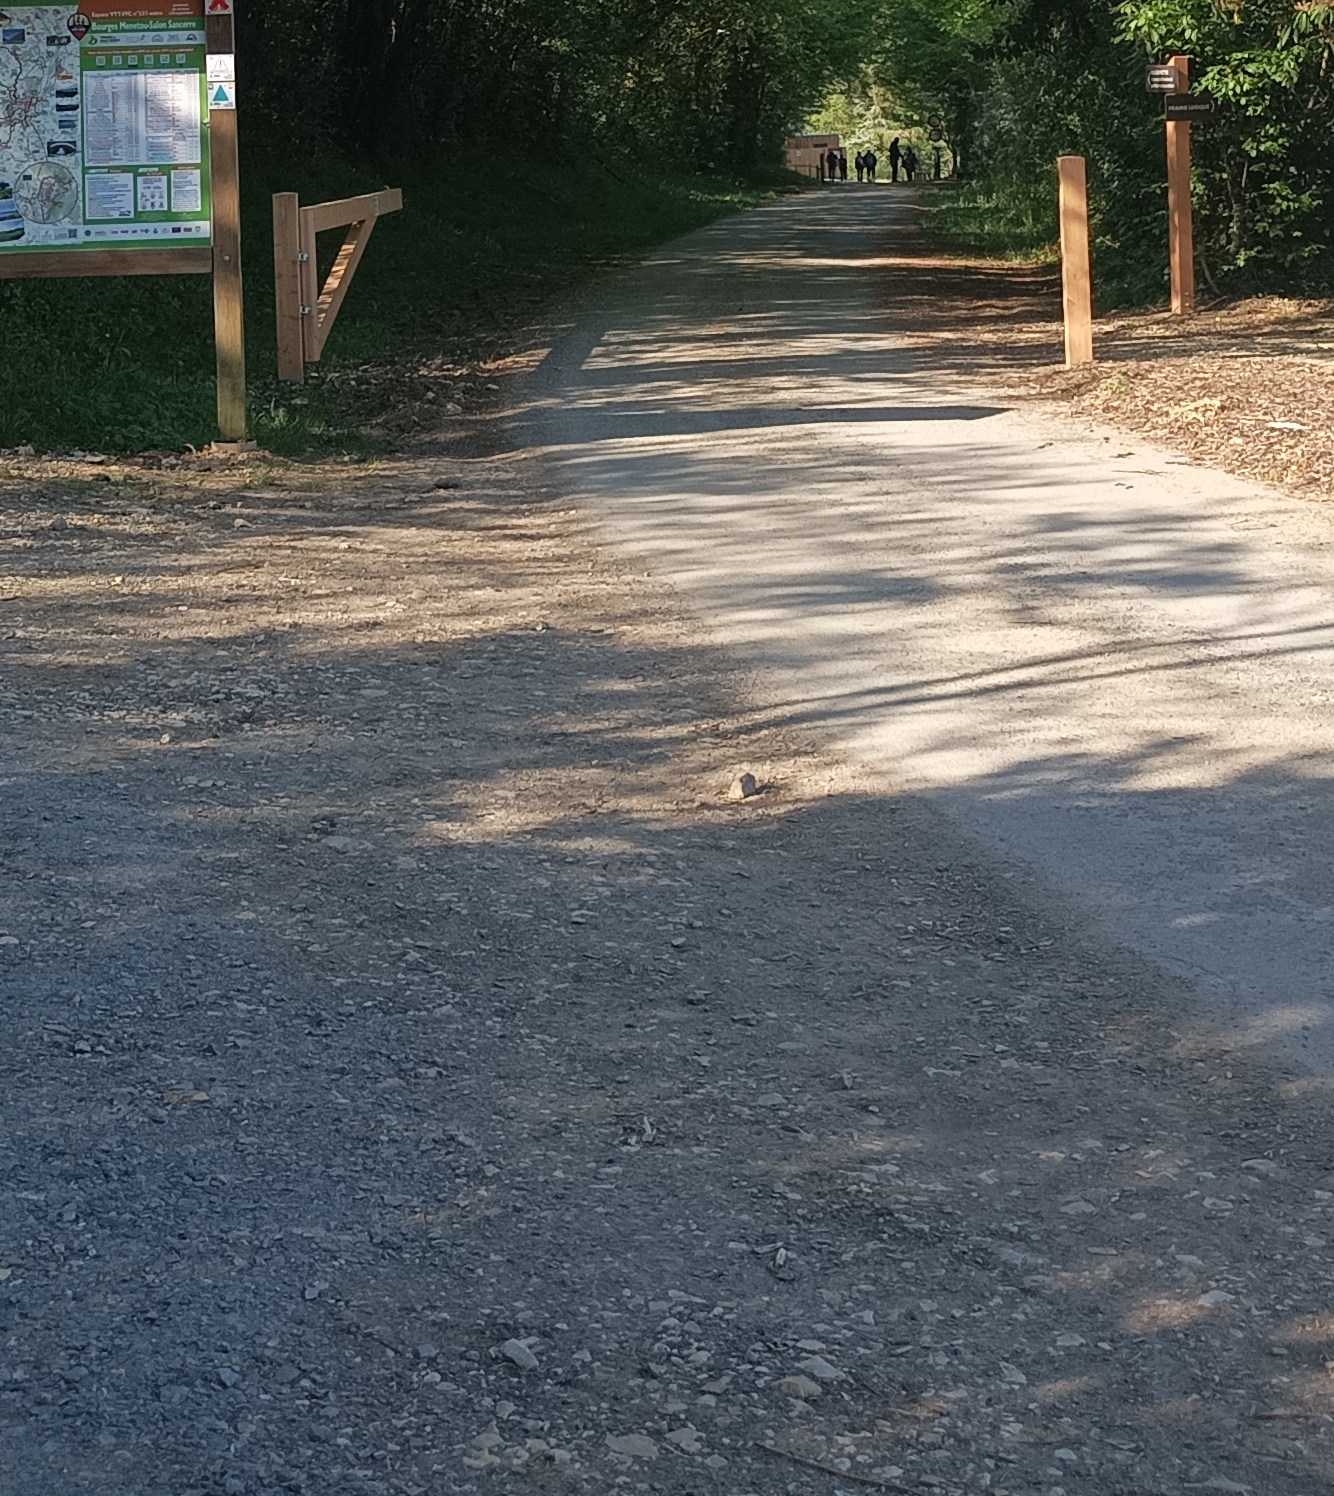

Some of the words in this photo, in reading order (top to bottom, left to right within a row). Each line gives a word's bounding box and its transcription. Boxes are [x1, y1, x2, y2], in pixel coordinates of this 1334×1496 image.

[91, 21, 118, 33] Bourges
[119, 20, 167, 30] Menetou-Salon
[168, 19, 197, 29] Sancerre
